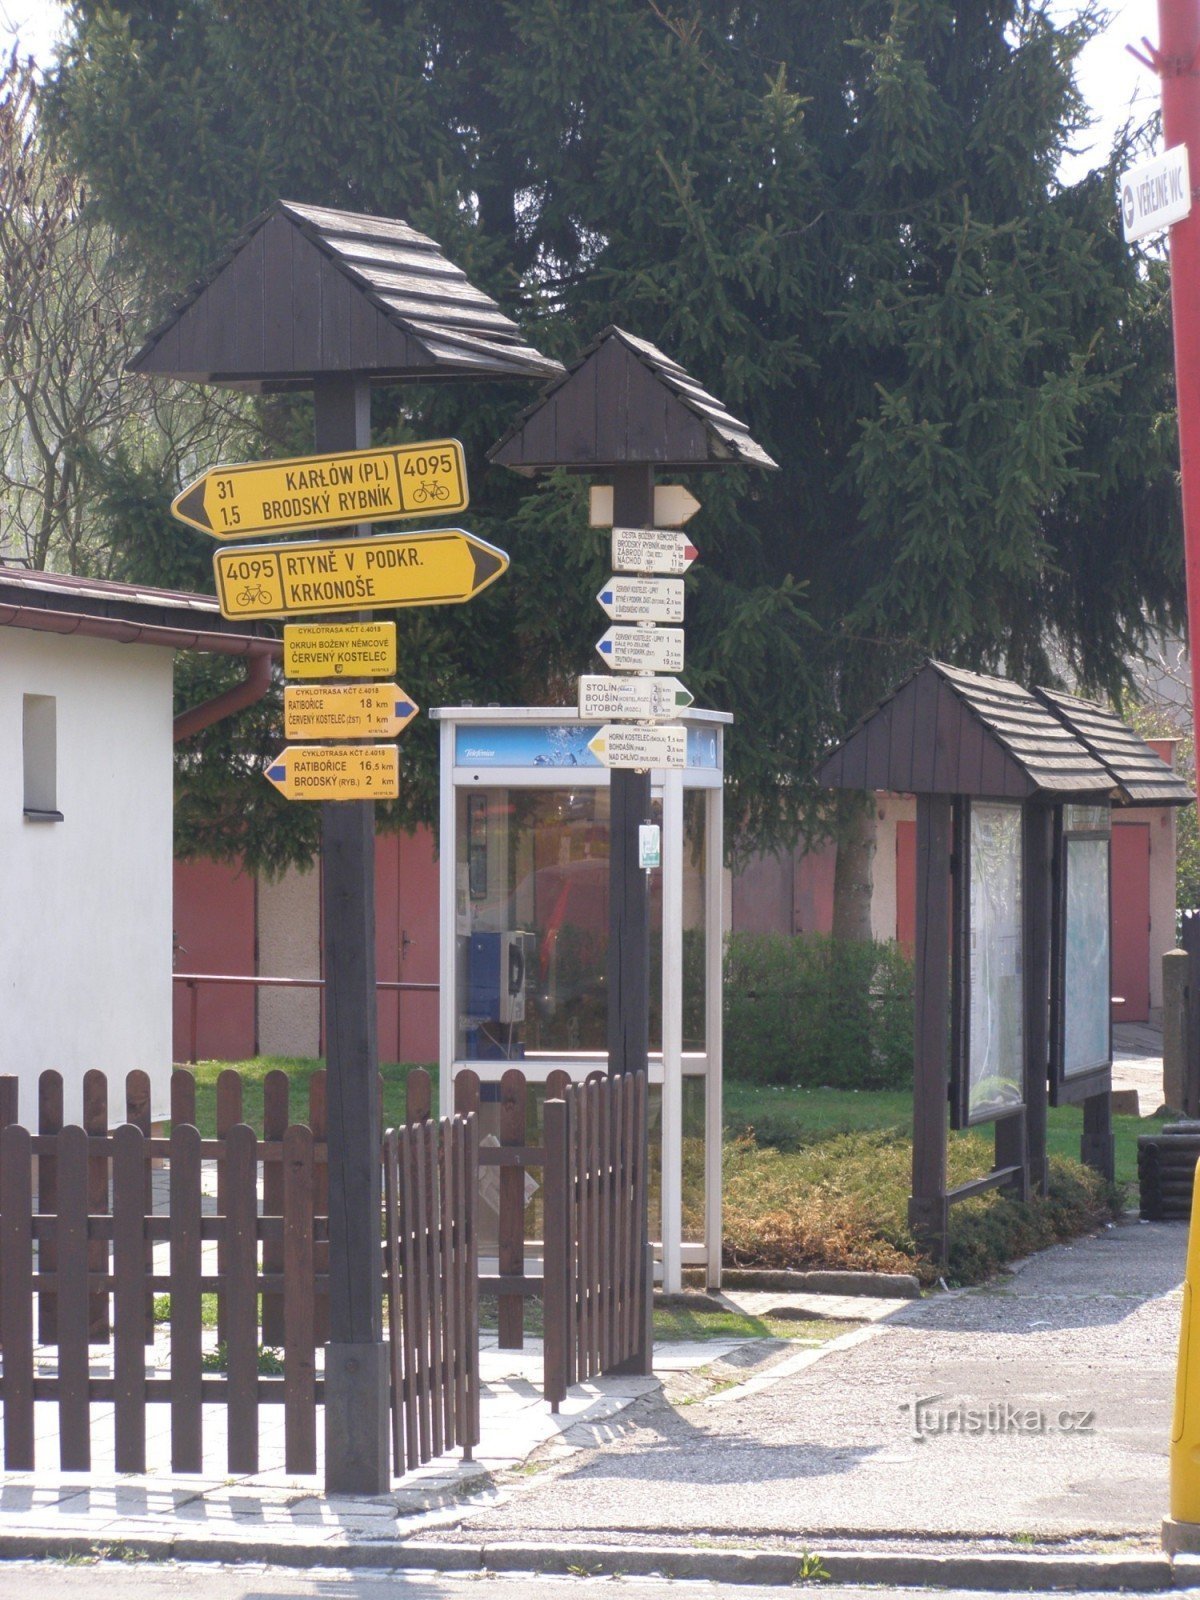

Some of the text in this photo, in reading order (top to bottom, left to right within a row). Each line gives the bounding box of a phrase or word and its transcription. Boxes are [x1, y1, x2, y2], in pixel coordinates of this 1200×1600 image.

[1169, 166, 1183, 204] WC
[403, 454, 452, 477] 4095
[285, 460, 389, 491] KARŁÓW (PL)
[216, 479, 235, 500] 31
[262, 484, 393, 521] BRODSKÝ RYBNÍK
[220, 505, 241, 526] 1,5
[287, 547, 424, 576] RTYNĚ V PODKR.
[617, 555, 641, 564] NÁCHOD
[226, 559, 274, 581] 4095
[290, 573, 375, 603] KRKONOŠE
[290, 641, 317, 649] OKRUH
[319, 639, 350, 649] BOŽENY
[292, 650, 387, 663] ČERVENÝ KOSTELEC
[296, 688, 342, 696] CYKLOTRASA
[586, 683, 617, 691] STOLÍN
[585, 692, 619, 701] BOUŠÍN
[288, 698, 324, 710] RATIBOŘICE
[360, 698, 372, 709] 18
[585, 703, 623, 712] LITOBOŘ
[288, 713, 315, 725] ČERVENÝ
[316, 713, 346, 724] KOSTELEC
[366, 714, 371, 723] 1
[609, 732, 624, 740] HORNÍ
[294, 760, 347, 771] RATIBOŘICE
[294, 774, 337, 787] BRODSKÝ
[366, 776, 372, 785] 2
